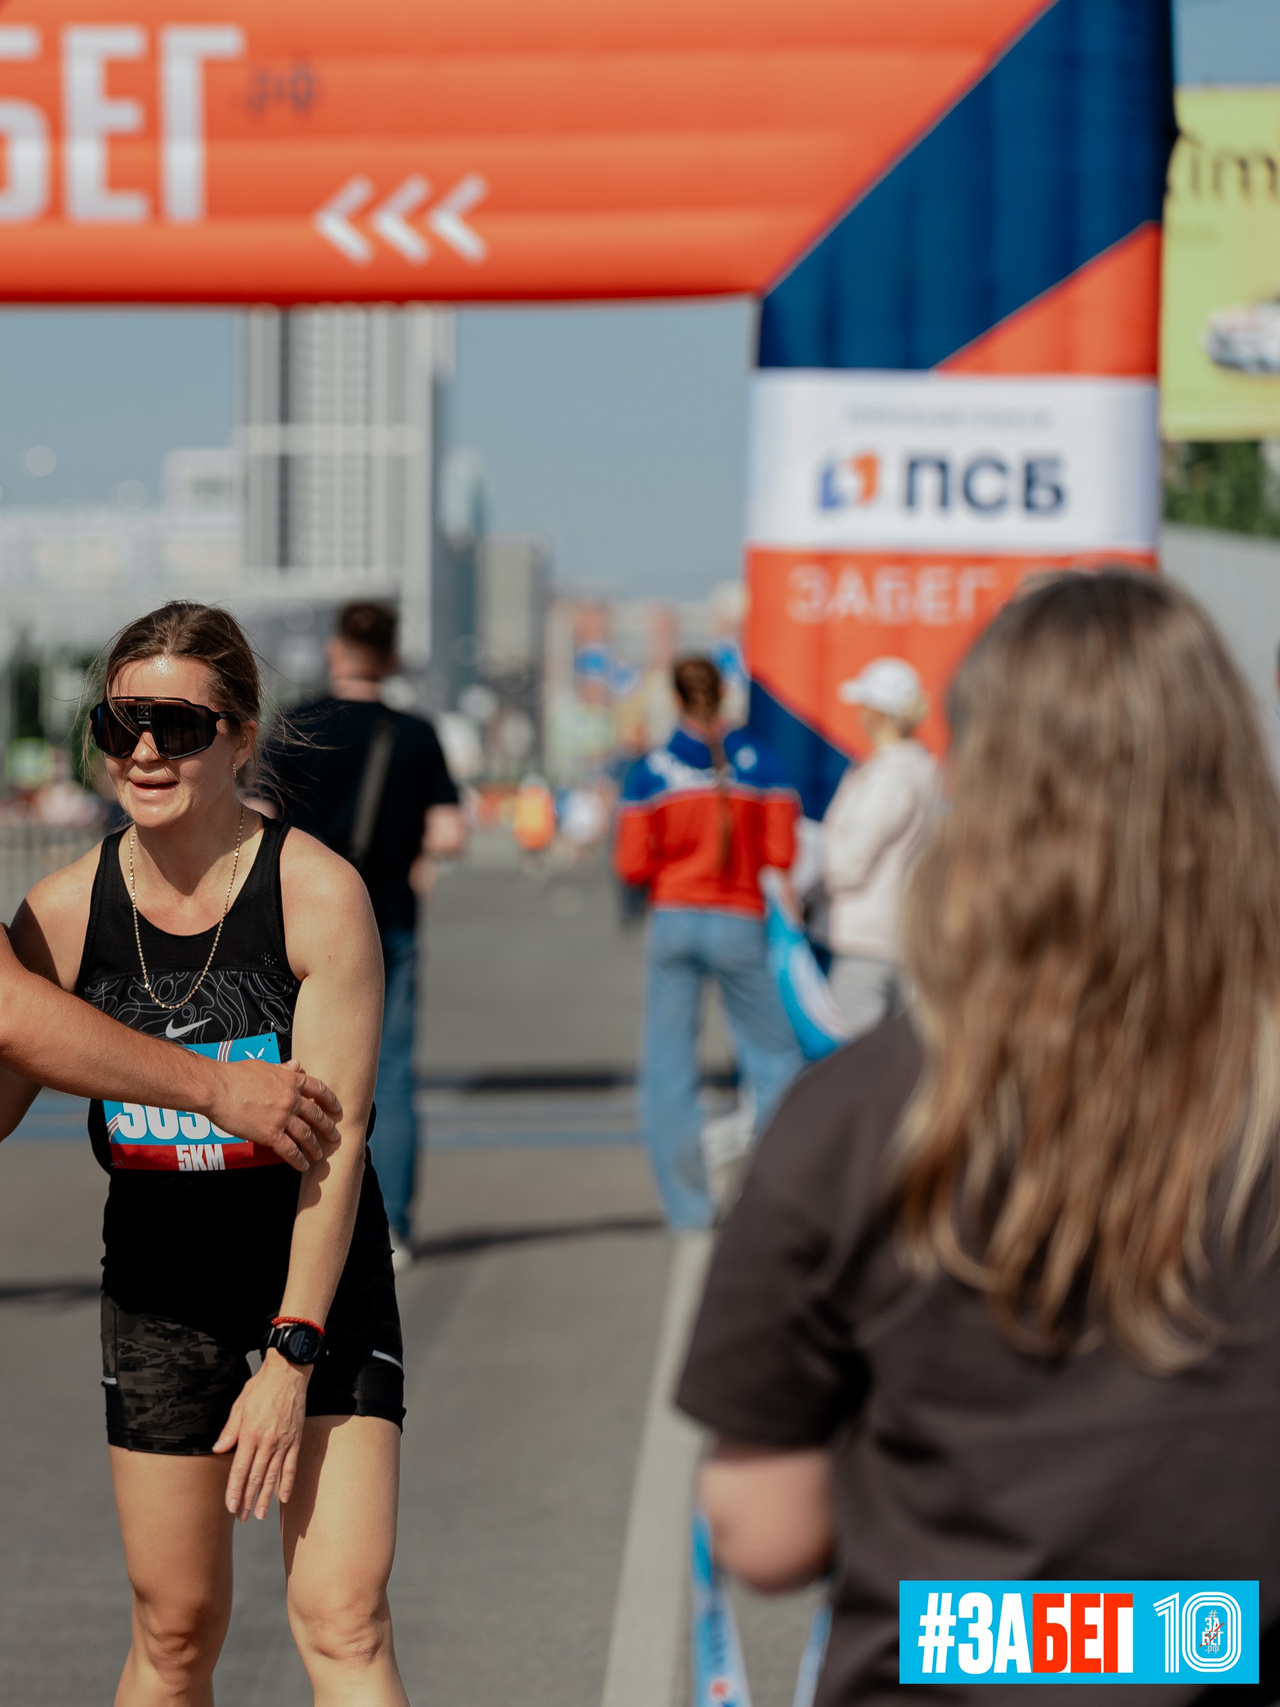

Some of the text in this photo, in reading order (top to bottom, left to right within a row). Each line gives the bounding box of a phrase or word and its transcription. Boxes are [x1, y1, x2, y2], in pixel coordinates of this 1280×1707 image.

[906, 456, 1066, 514] ПСБ
[787, 565, 996, 625] ЗАБЕГ
[119, 1102, 236, 1140] 303
